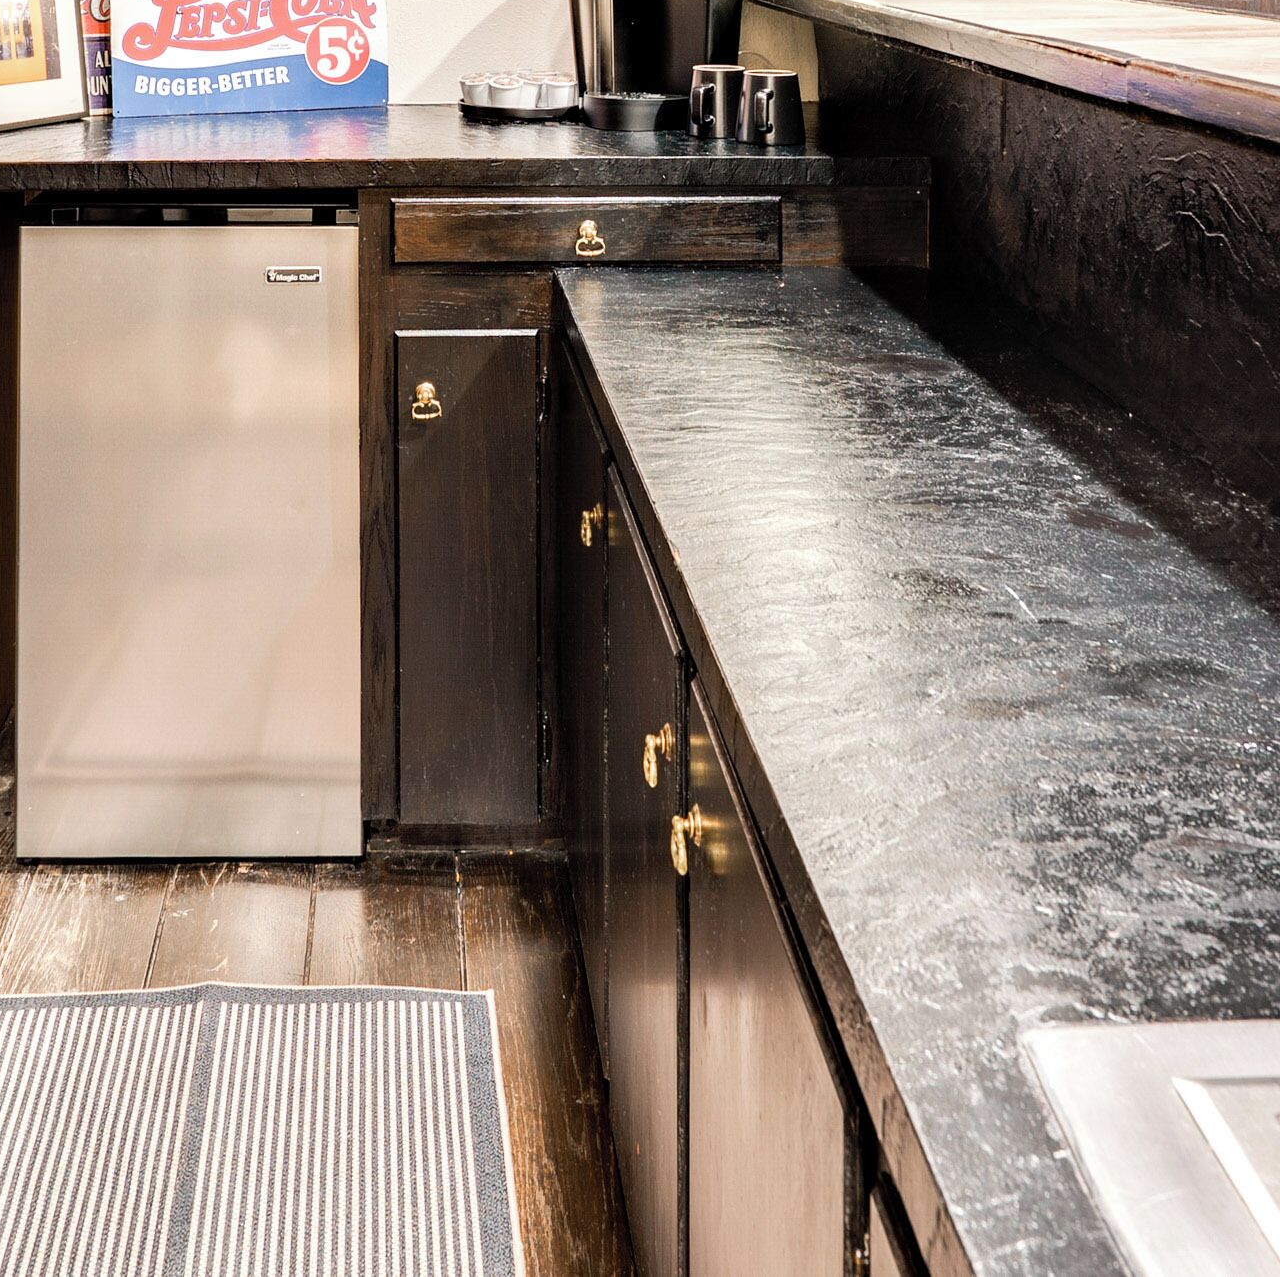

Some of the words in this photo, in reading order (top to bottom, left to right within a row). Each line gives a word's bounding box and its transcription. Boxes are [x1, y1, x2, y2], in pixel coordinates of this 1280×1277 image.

[134, 65, 290, 97] BIGGER-BETTER
[276, 274, 298, 282] Magic
[299, 273, 317, 281] Chef
